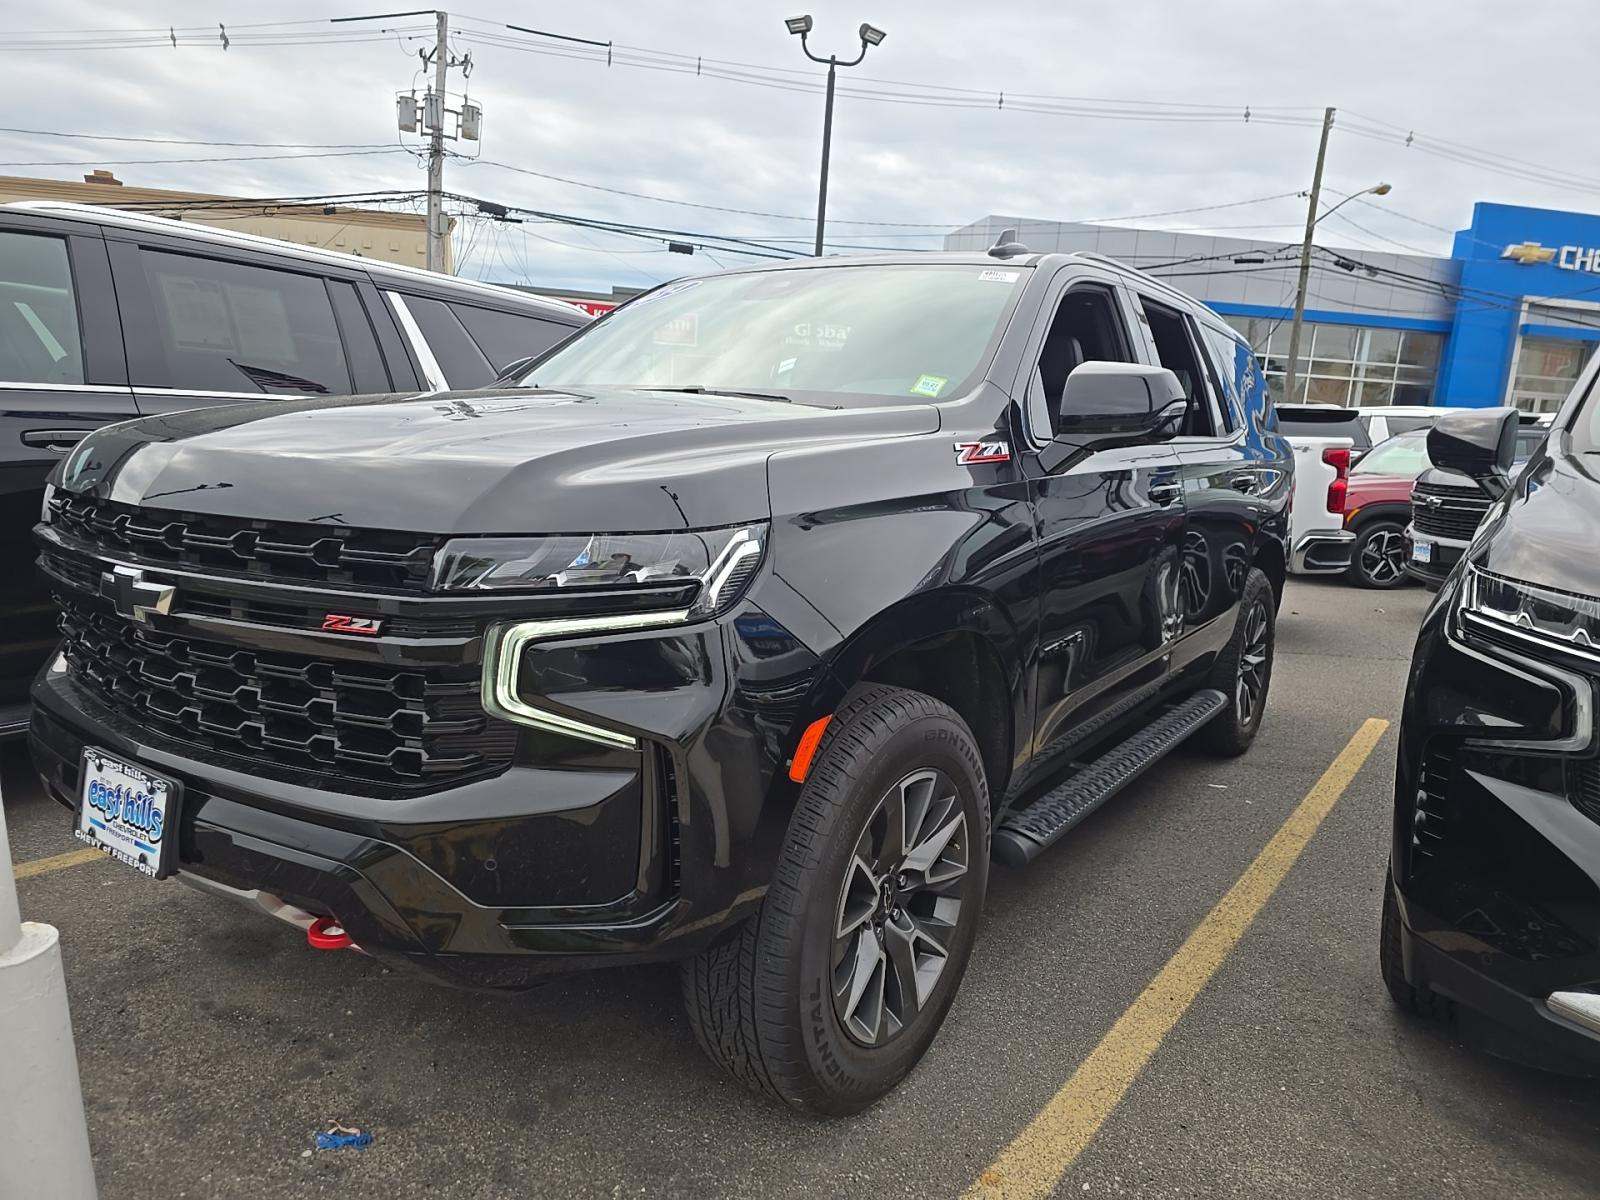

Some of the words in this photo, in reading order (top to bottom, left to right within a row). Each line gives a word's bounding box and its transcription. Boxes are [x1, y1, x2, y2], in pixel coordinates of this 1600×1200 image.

[88, 779, 122, 822] east
[121, 787, 163, 845] hills
[74, 829, 103, 850] CHEVY
[102, 844, 113, 856] of
[111, 848, 159, 879] FREEPORT
